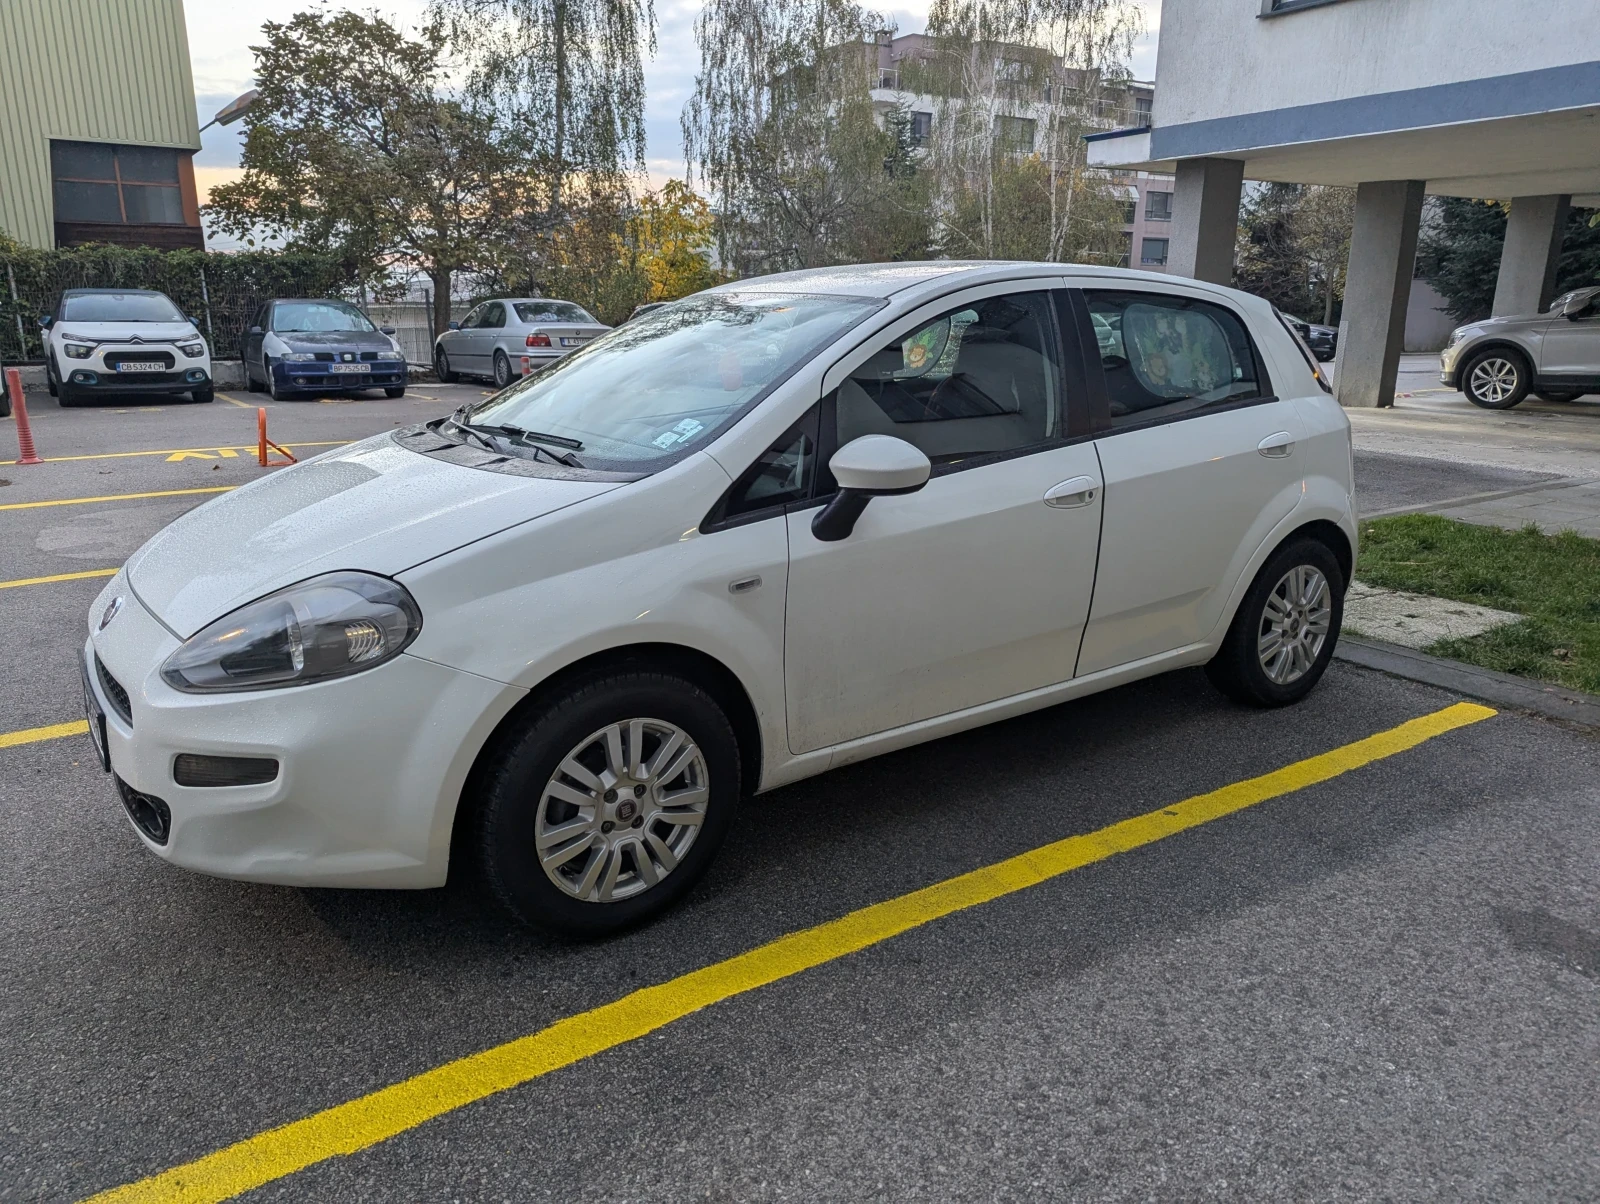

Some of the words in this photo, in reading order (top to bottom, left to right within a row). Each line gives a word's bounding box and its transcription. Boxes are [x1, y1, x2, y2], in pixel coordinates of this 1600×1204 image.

[121, 363, 132, 371] CB
[133, 363, 153, 371] 5324
[153, 363, 164, 371] CH
